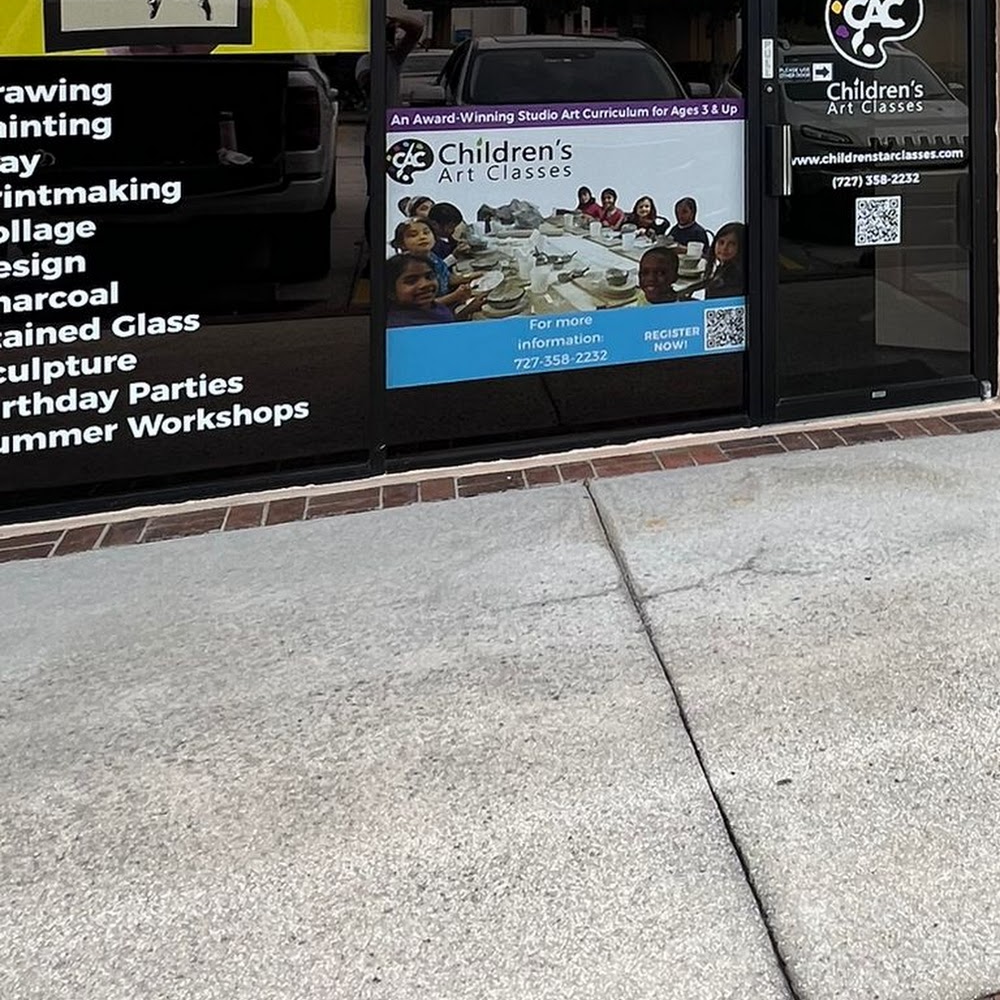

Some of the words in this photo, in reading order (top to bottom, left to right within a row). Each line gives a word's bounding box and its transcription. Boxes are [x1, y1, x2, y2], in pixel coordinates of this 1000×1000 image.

[827, 77, 924, 101] Children's
[390, 114, 410, 126] An
[413, 110, 515, 125] Award-Winning
[518, 108, 558, 121] Studio
[561, 109, 580, 120] Art
[583, 107, 649, 119] Curriculum
[652, 106, 668, 118] for
[670, 105, 699, 118] Ages
[702, 104, 709, 116] 3
[711, 104, 719, 115] &
[721, 104, 738, 116] Up
[827, 102, 854, 115] Art
[861, 100, 923, 114] Classes
[392, 143, 427, 168] CAC
[438, 137, 573, 166] Children's
[438, 167, 474, 183] Art
[487, 165, 572, 181] Classes
[832, 175, 863, 189] (727)
[865, 172, 920, 186] 358-2232
[0, 177, 182, 208] intmaking
[0, 317, 100, 349] ained
[112, 313, 200, 338] Glass
[529, 317, 551, 331] For
[556, 314, 593, 328] more
[644, 326, 700, 341] REGISTER
[654, 340, 688, 352] NOW!
[514, 350, 608, 370] 727-358-2232
[129, 373, 244, 405] Parties
[127, 401, 309, 438] Workshops
